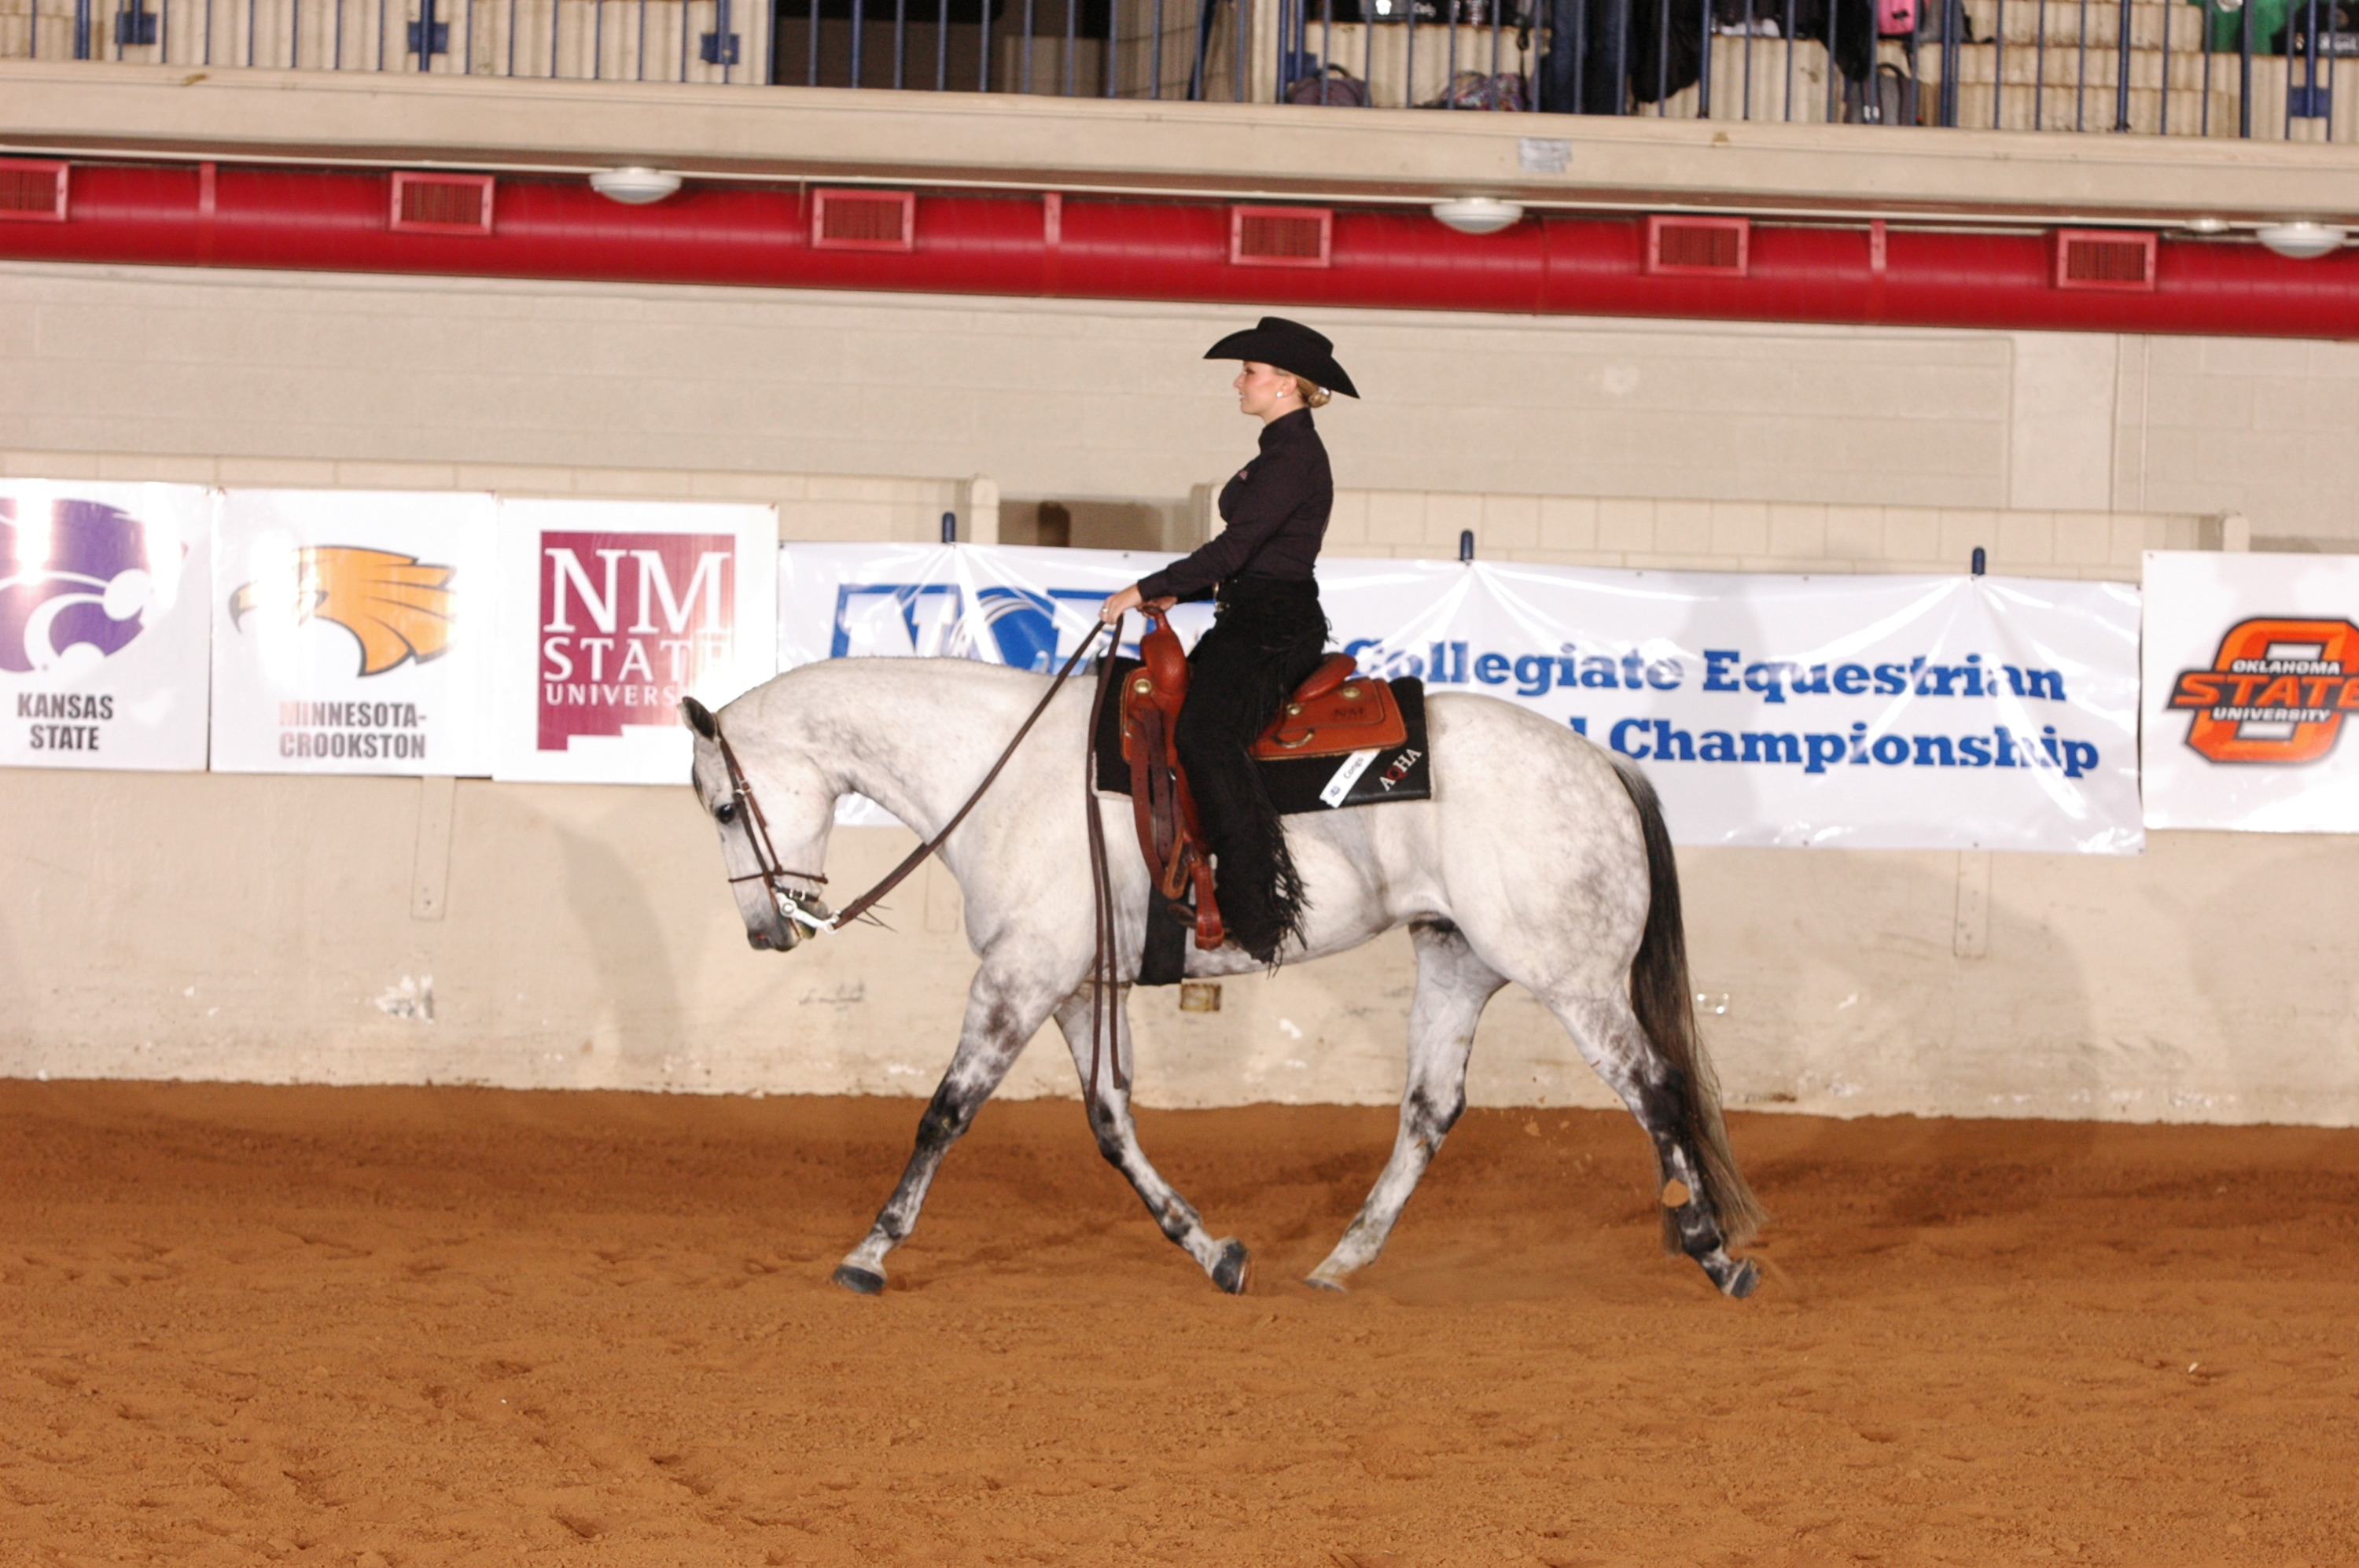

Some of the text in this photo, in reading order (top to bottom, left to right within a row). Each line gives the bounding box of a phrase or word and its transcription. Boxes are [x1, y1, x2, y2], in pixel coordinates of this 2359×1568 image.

[543, 548, 732, 634] NM
[543, 636, 727, 683] STATE
[1343, 638, 2067, 703] Collegiate Equestrian
[2232, 659, 2340, 675] OKLAHOMA
[546, 683, 688, 706] UNIVERS
[2174, 673, 2359, 707] STATE
[17, 692, 113, 720] KANSAS
[279, 701, 427, 727] MINNESOTA-
[2212, 707, 2331, 722] UNIVERSITY
[30, 723, 99, 750] STATE
[280, 732, 425, 759] CROOKSTON
[1610, 718, 2099, 778] Championship
[1379, 748, 1422, 791] AQHA
